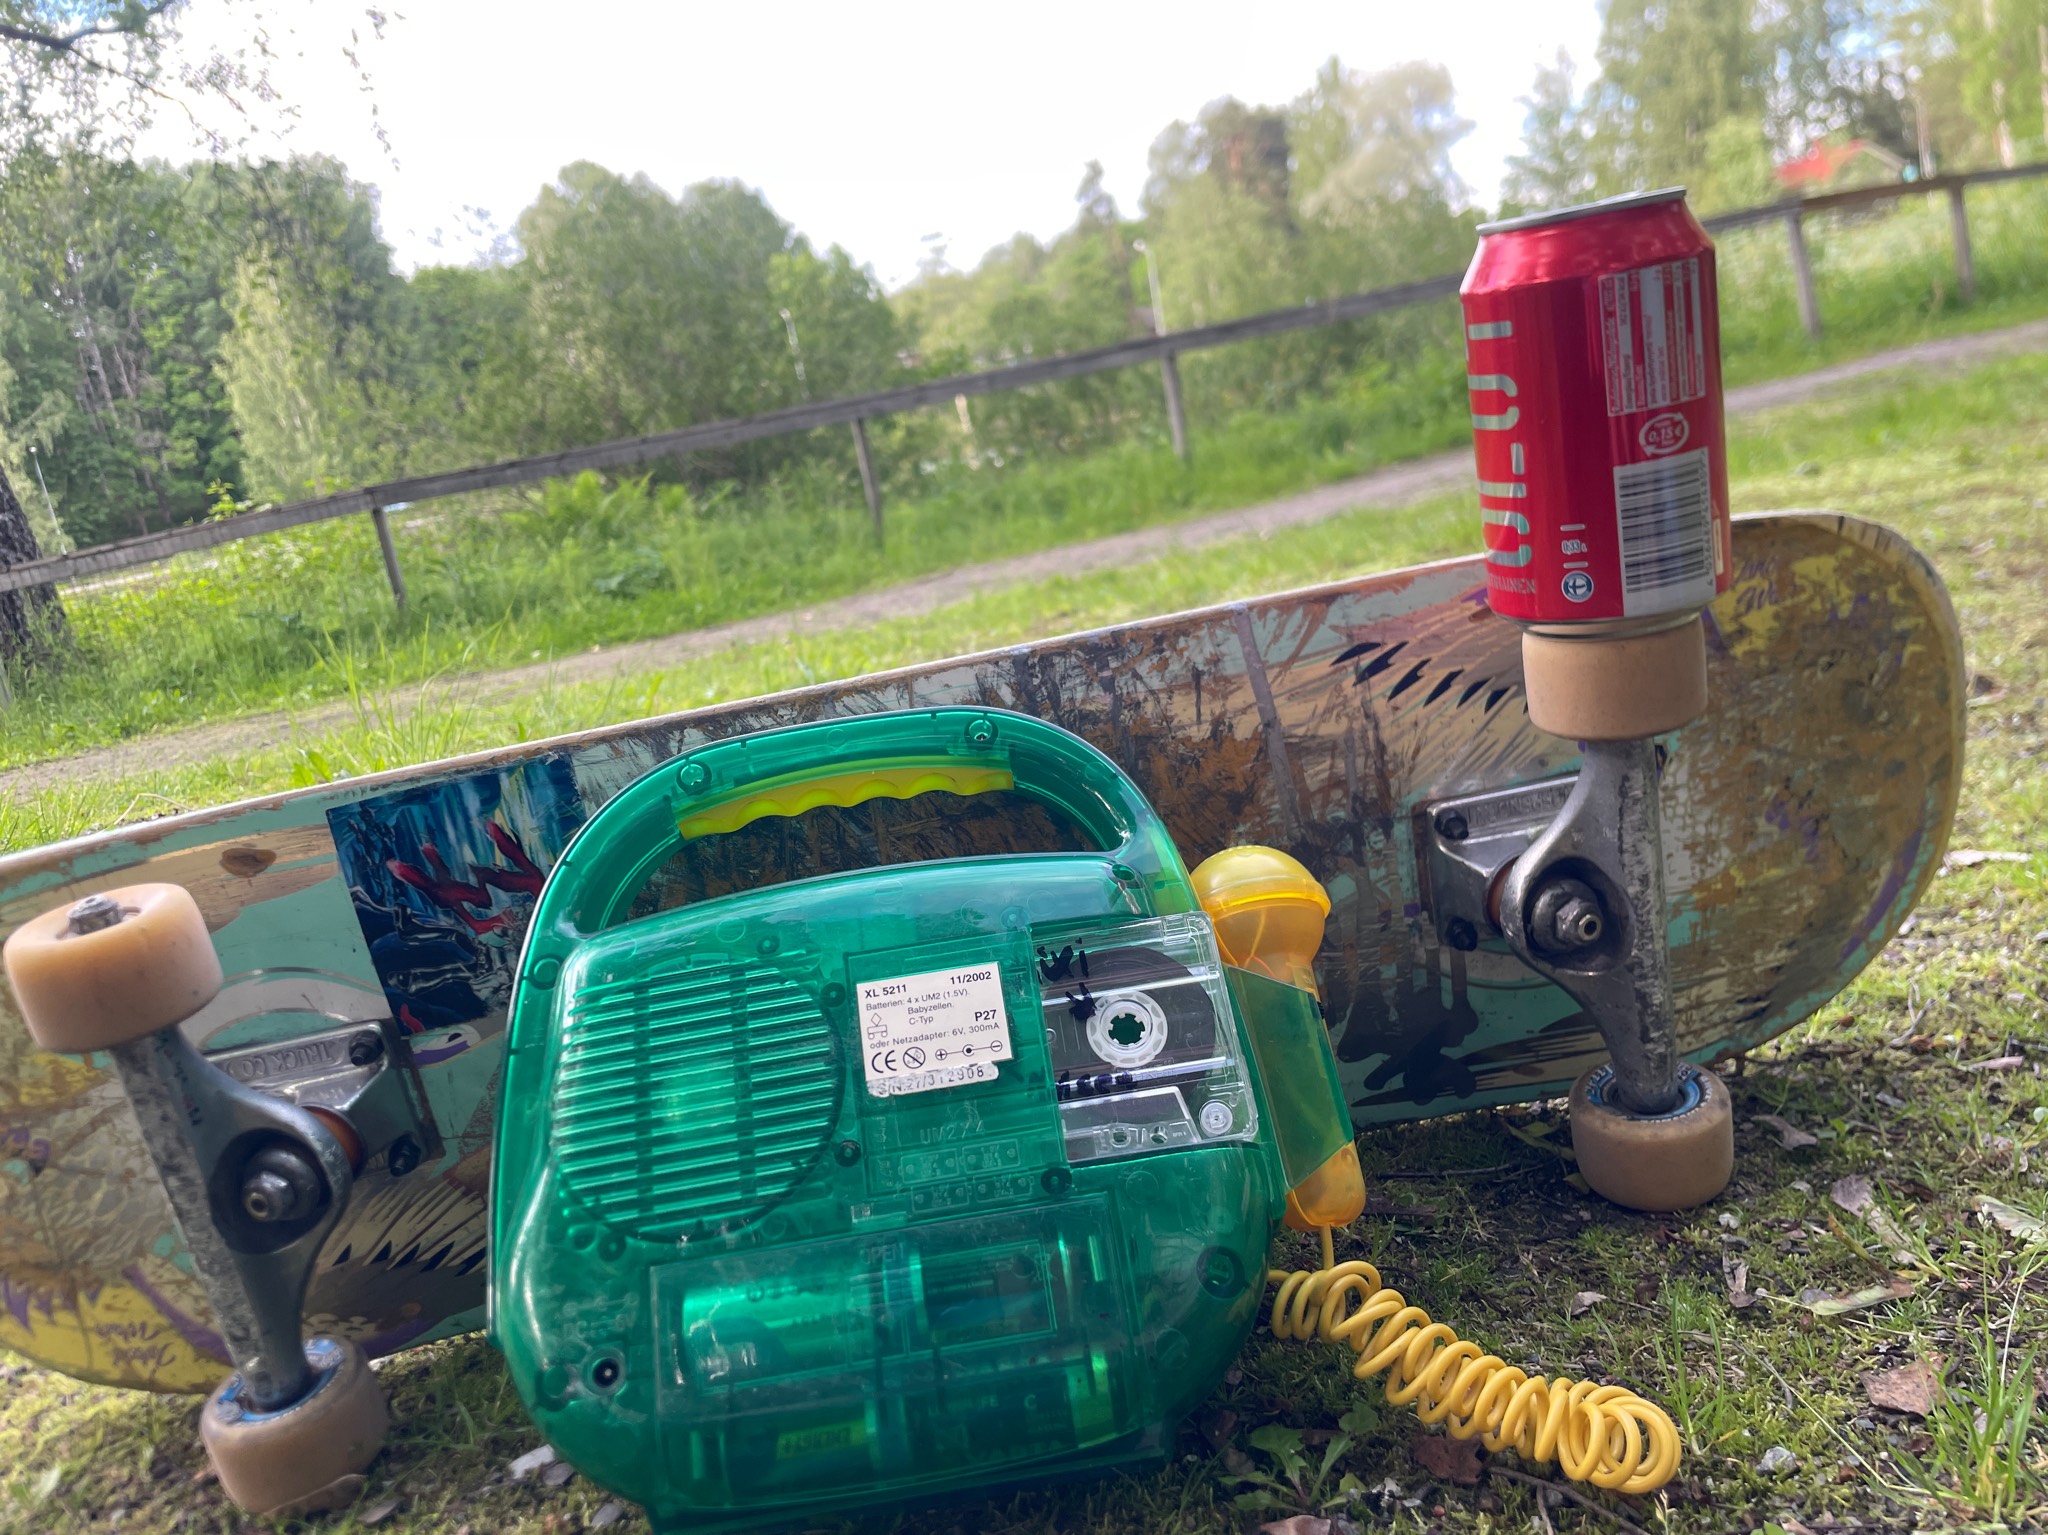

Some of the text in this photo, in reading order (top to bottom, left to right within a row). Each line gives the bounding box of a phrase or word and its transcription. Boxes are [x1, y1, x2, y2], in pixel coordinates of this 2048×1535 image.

[864, 971, 992, 999] XL 5211 11/2002
[866, 999, 905, 1011] Batterien:
[907, 996, 912, 1004] 4
[921, 992, 941, 1002] UM2
[908, 1002, 954, 1015] Babyzellen.
[909, 1016, 934, 1026] C-Typ
[974, 1009, 997, 1022] P27
[870, 1040, 890, 1050] oder
[893, 1030, 950, 1046] Netzadapter:
[969, 1022, 1000, 1034] 300mA
[241, 1042, 334, 1078] TRUCK CO
